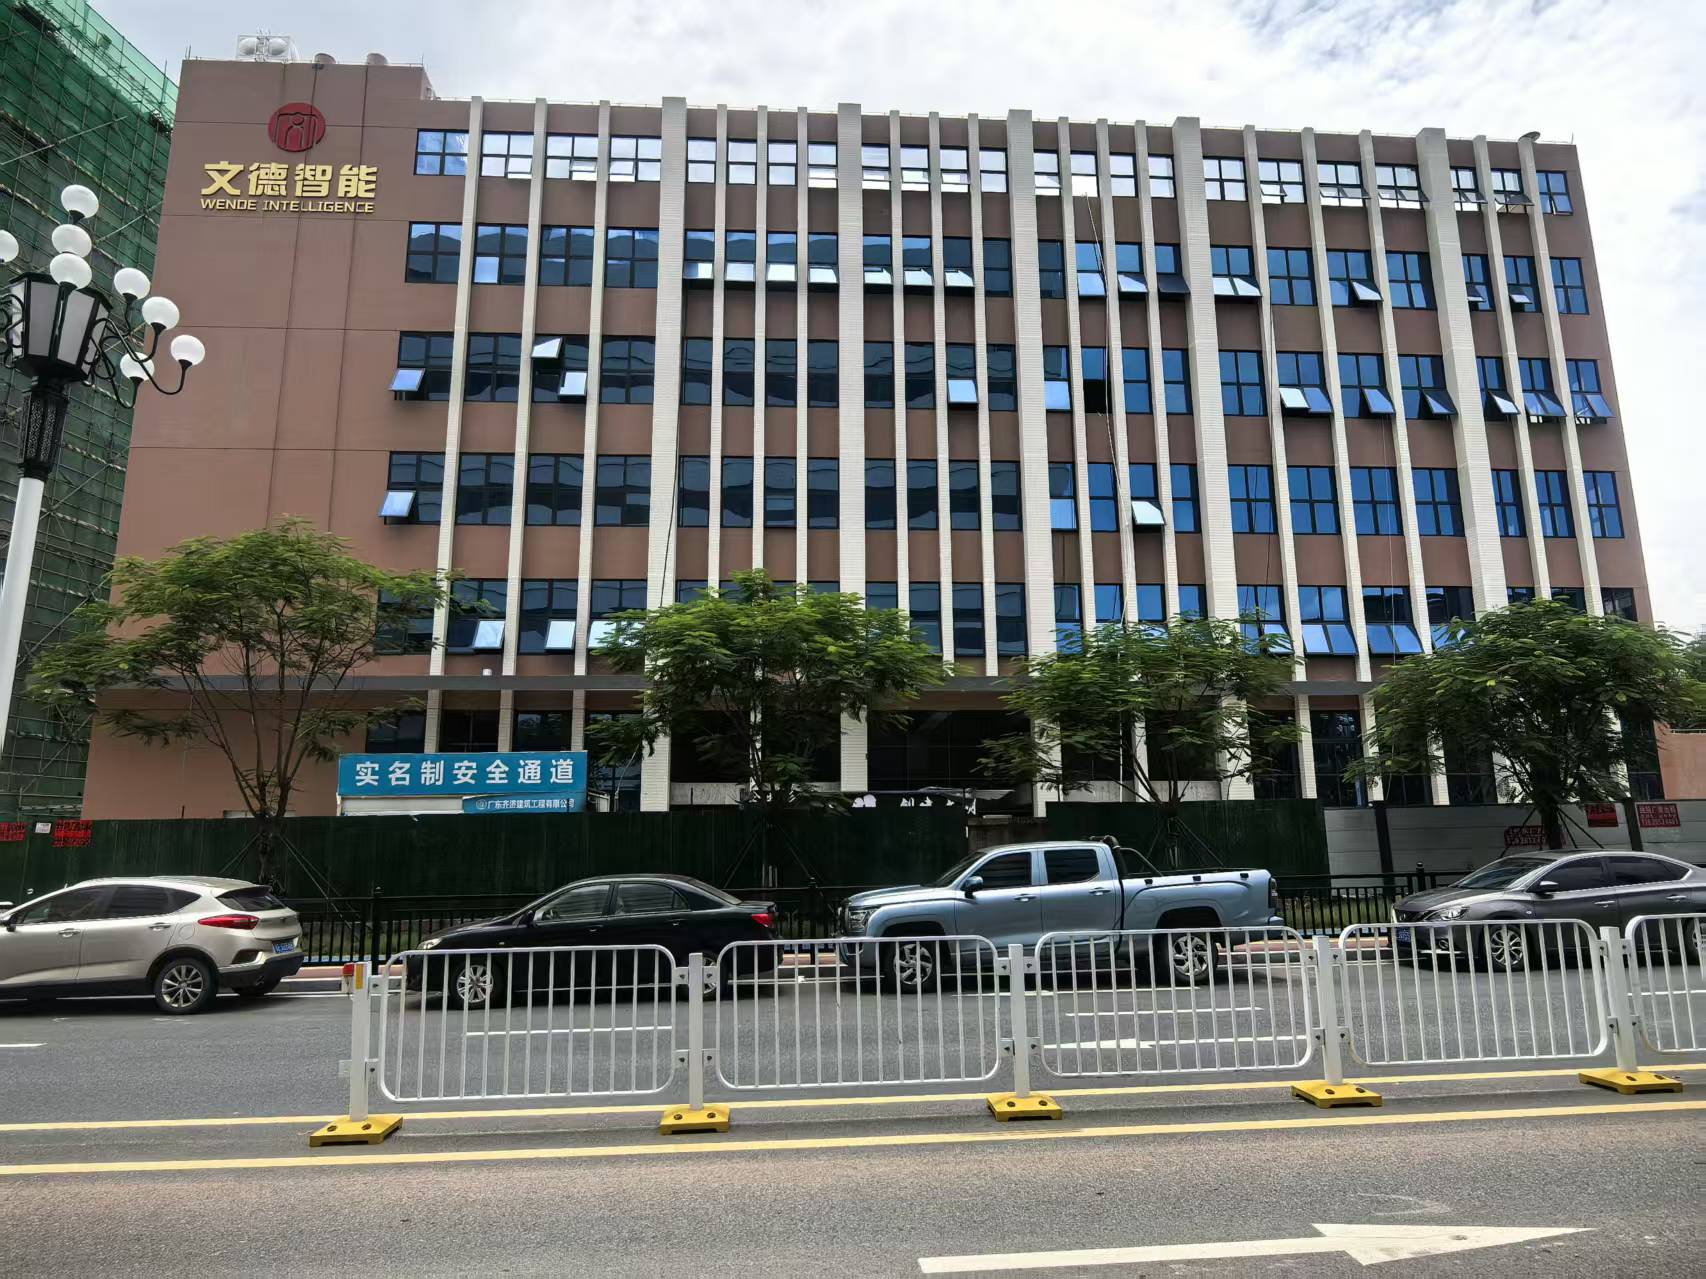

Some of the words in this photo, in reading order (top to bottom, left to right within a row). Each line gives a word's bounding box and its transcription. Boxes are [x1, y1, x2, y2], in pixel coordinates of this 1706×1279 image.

[201, 161, 378, 198] 文德智能
[201, 199, 257, 211] WENDE
[262, 201, 374, 213] INTELLIGENCE
[355, 759, 574, 786] 实名制安全通道
